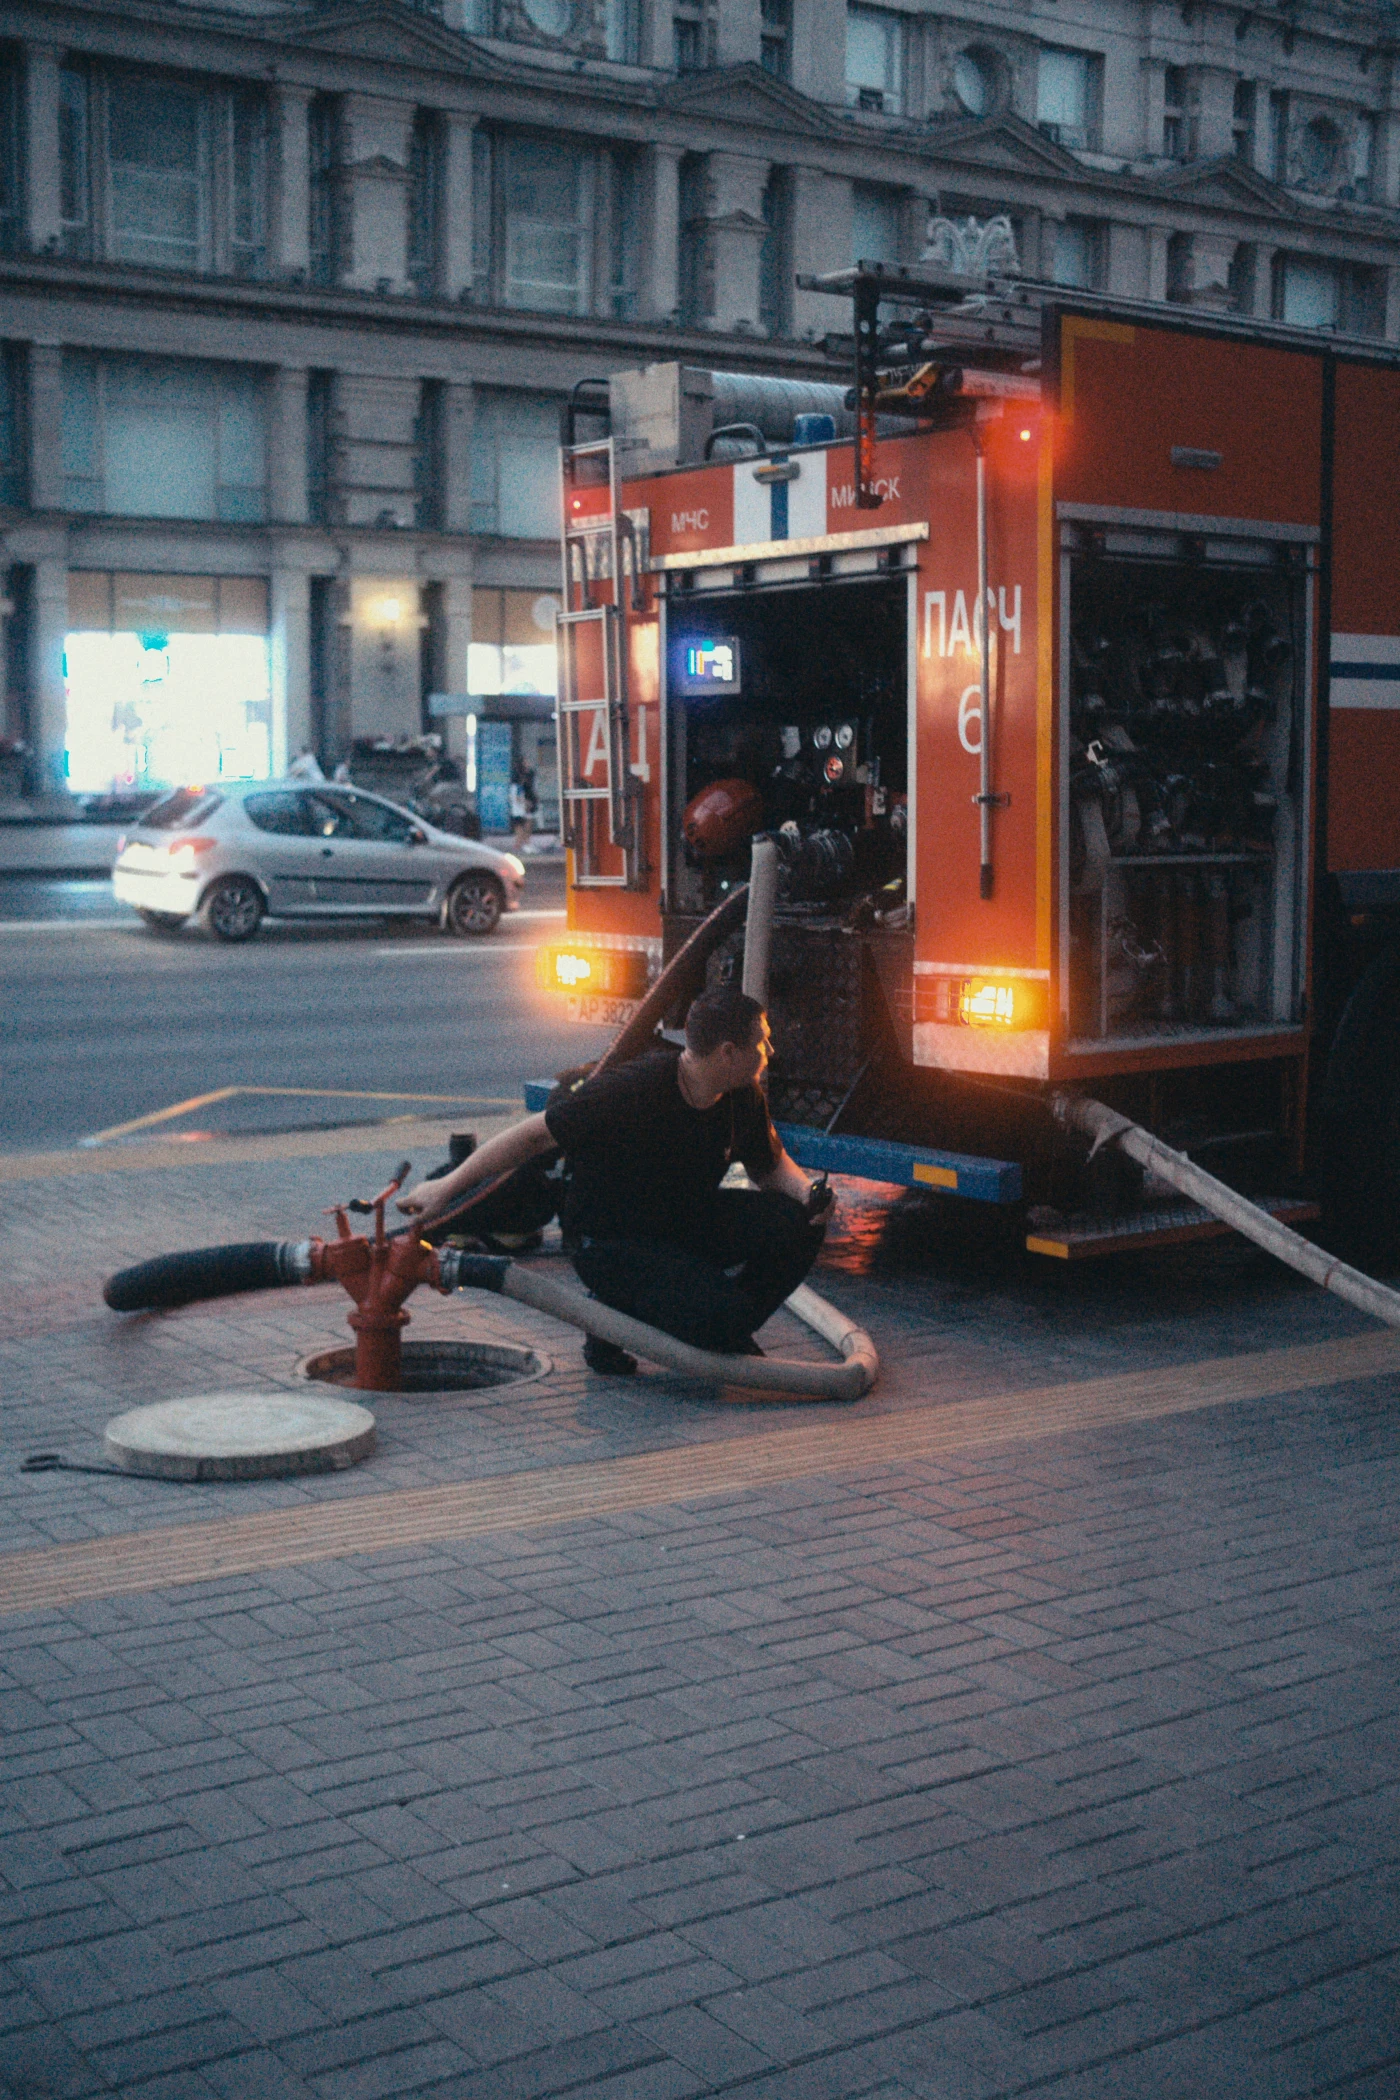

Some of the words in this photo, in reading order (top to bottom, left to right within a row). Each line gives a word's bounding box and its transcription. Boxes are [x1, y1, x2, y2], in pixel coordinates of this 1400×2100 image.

[671, 508, 710, 533] МЧС
[923, 584, 1022, 658] ПАСЧ
[957, 684, 984, 755] 6
